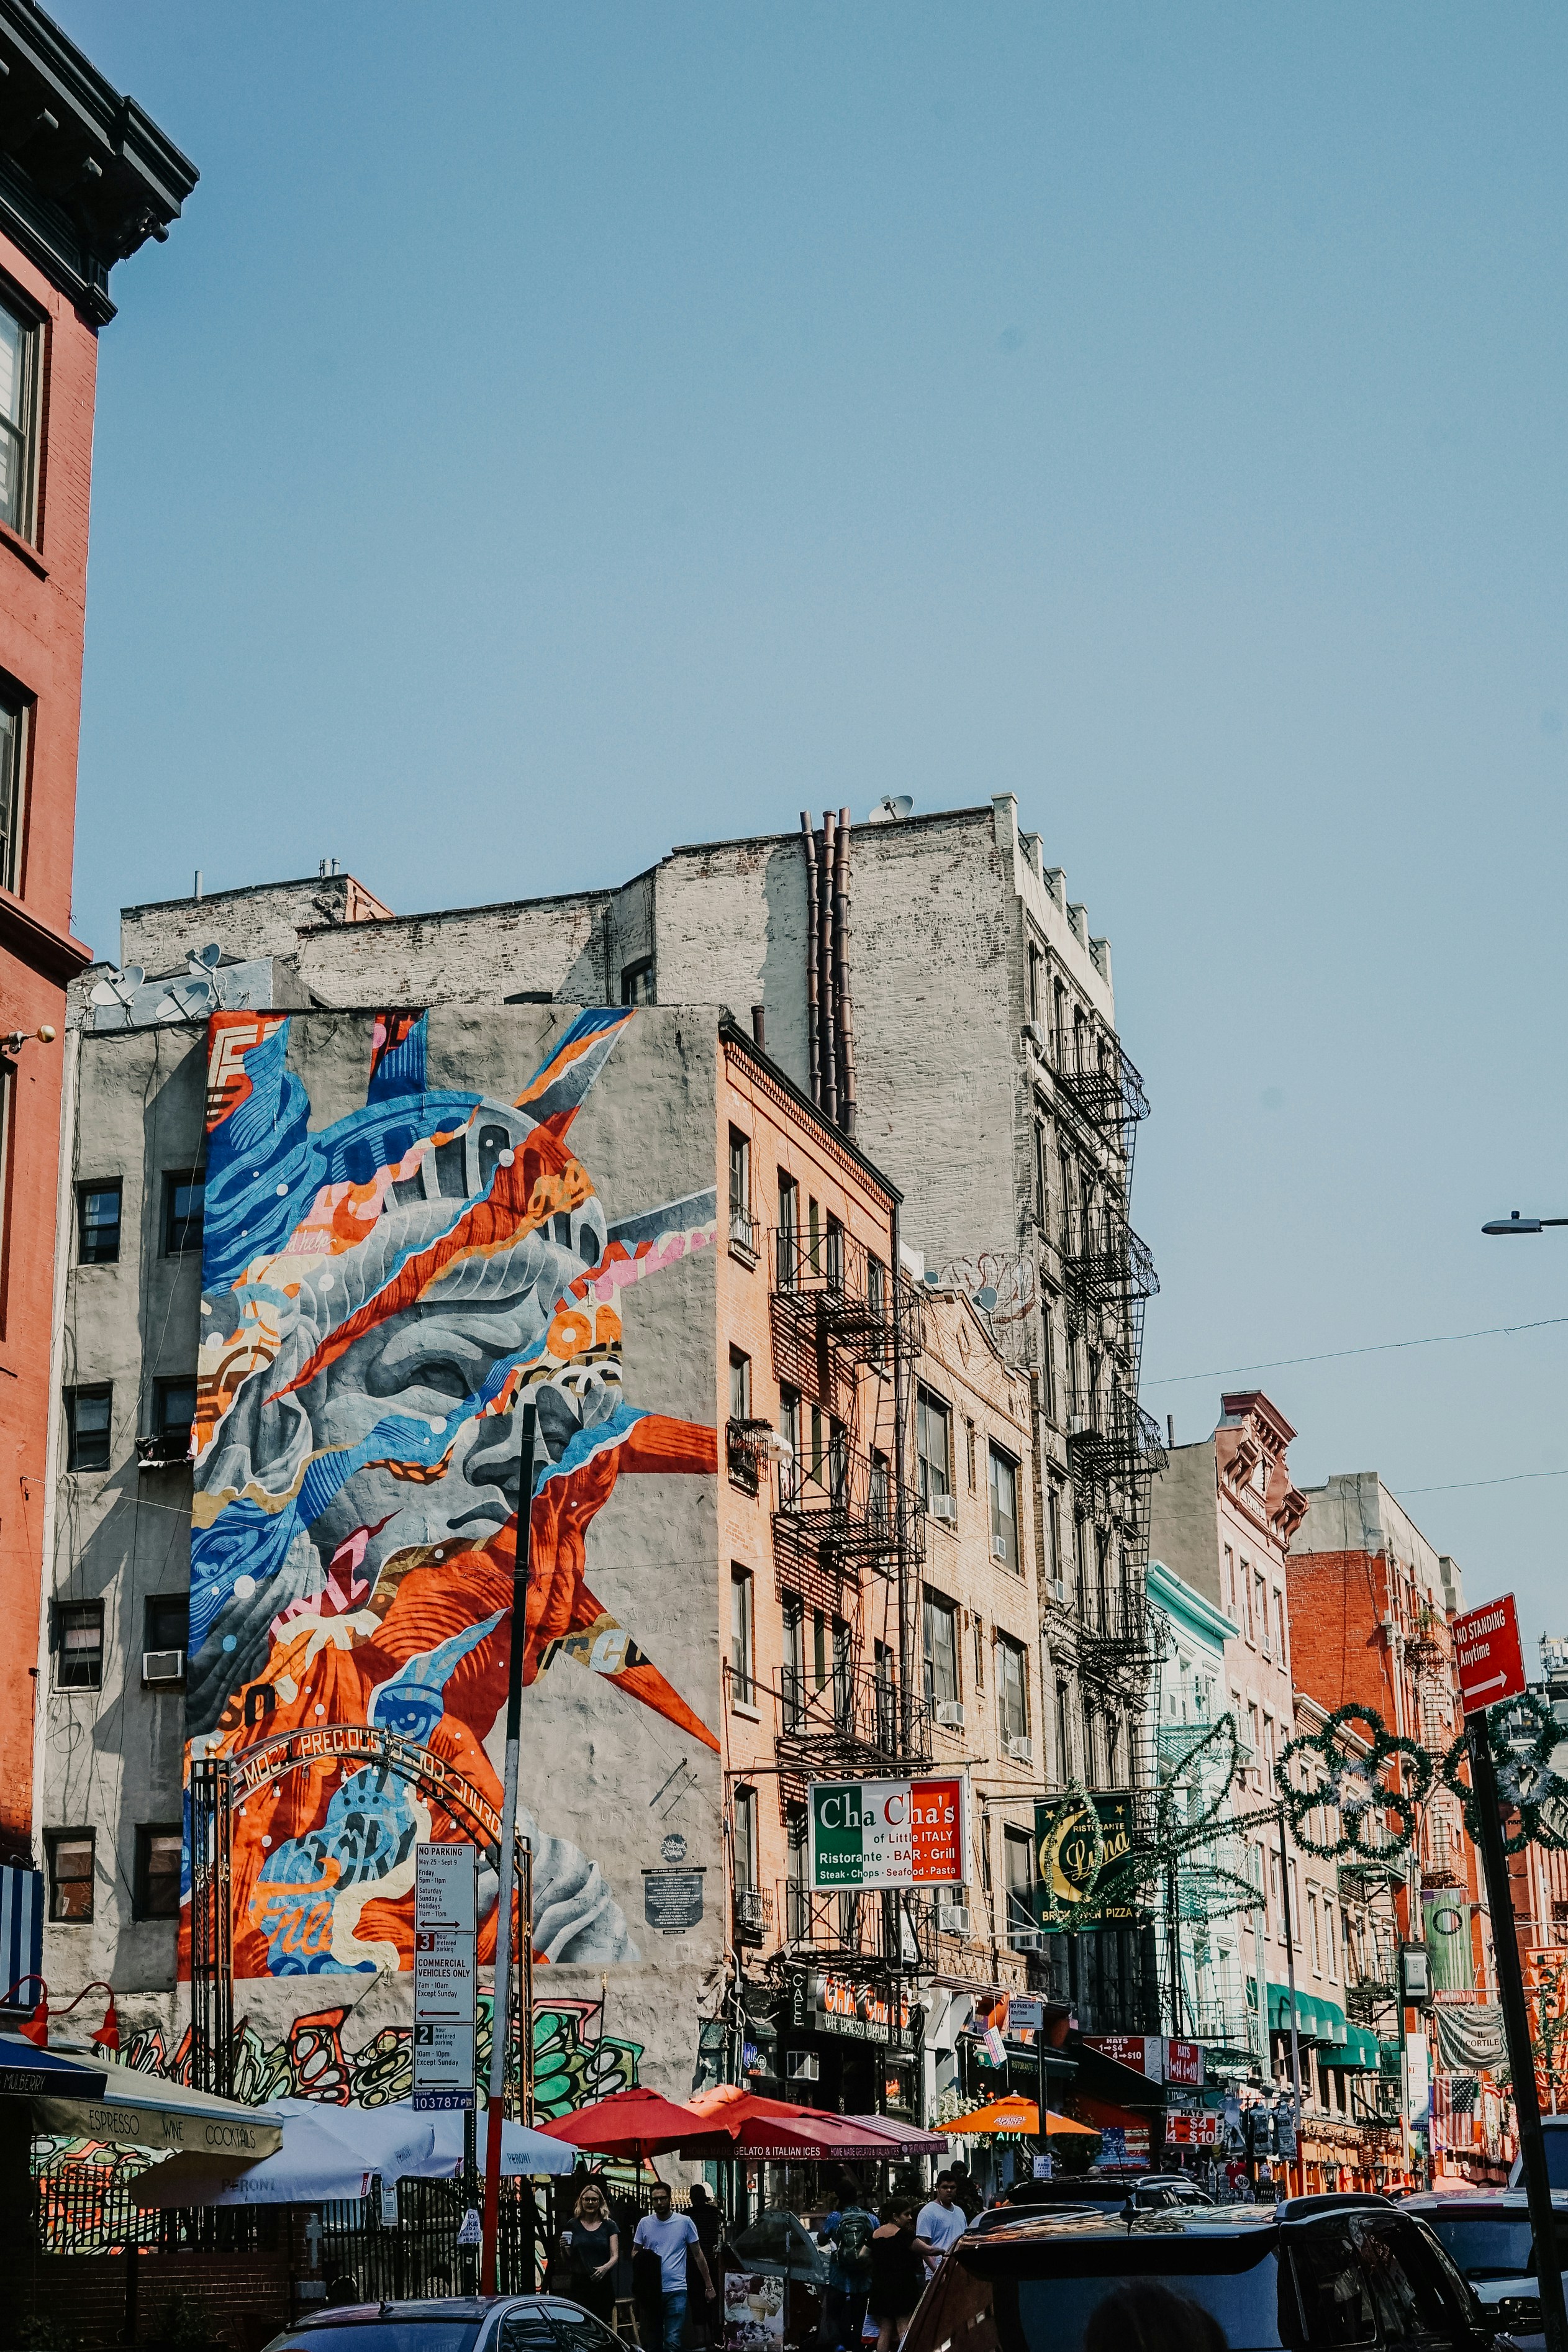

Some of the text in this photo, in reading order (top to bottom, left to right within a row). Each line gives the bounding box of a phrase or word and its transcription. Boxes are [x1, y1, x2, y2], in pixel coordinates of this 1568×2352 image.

[1456, 1609, 1505, 1646] NO STANDING
[1460, 1642, 1490, 1668] Anytime
[301, 1728, 381, 1759] PRECOUS
[820, 1789, 954, 1829] Cha Cha's
[874, 1830, 953, 1843] of Little ITALY
[419, 1847, 463, 1856] NO PARKING
[819, 1847, 955, 1864] Ristorante BAR Grill
[820, 1866, 956, 1879] Steak Chops Seafood Pasta
[1106, 1907, 1133, 1918] PIZZA
[420, 1933, 430, 1950] 3
[418, 1959, 466, 1968] COMMERCIAL
[418, 1969, 470, 1977] VEHICLES ONLY
[418, 1990, 457, 1998] Except Sunday
[793, 1973, 806, 2026] CAFE
[419, 2026, 428, 2043] 2
[1112, 2044, 1123, 2052] $4
[1466, 2038, 1500, 2047] CORTILE
[1127, 2051, 1142, 2059] $10
[1177, 2045, 1190, 2059] HATS
[1176, 2059, 1182, 2079] $4
[1189, 2061, 1197, 2081] $10
[3, 2073, 47, 2092] MULBERRY
[415, 2097, 459, 2109] 103787
[89, 2109, 256, 2150] ESPRESSO WINE COCKTAILS
[1168, 2117, 1208, 2130] 1 $4
[1167, 2129, 1215, 2143] 4 $10
[733, 2146, 764, 2156] GELATO
[765, 2146, 771, 2156] &
[773, 2146, 801, 2156] ITALIAN
[803, 2147, 820, 2156] ICES
[830, 2147, 843, 2156] HOME
[844, 2147, 856, 2156] MADE
[507, 2153, 532, 2164] PERONI
